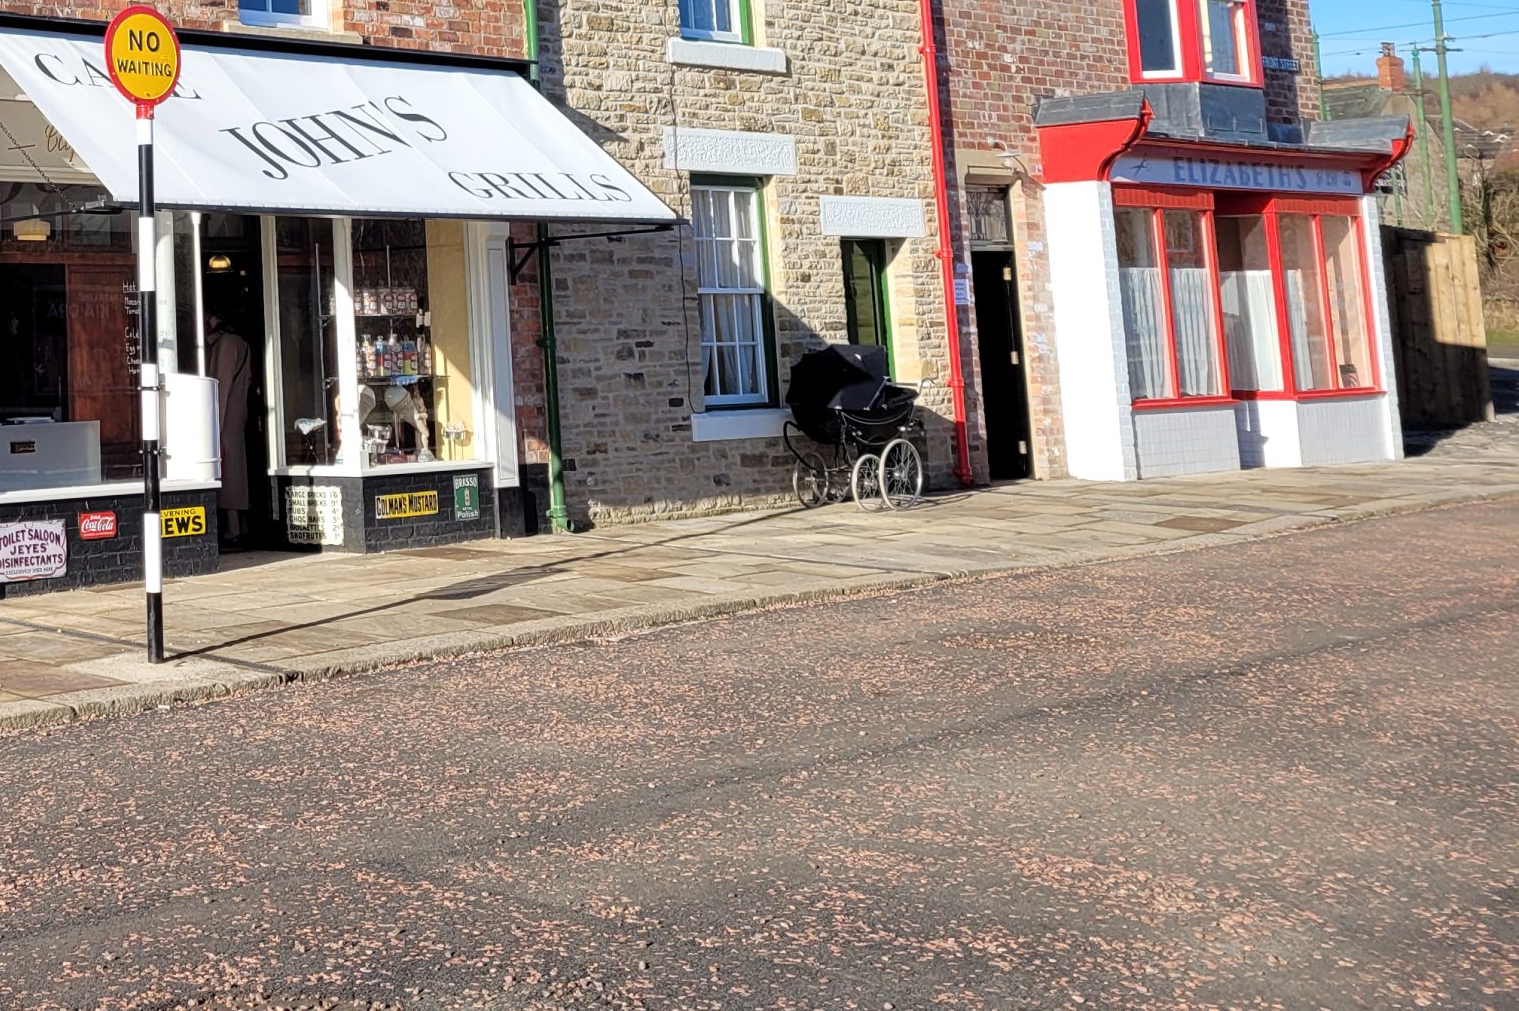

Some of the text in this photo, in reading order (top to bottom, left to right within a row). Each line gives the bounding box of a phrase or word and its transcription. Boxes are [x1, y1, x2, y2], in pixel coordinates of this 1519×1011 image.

[128, 29, 161, 53] NO
[116, 57, 172, 78] WAITING
[219, 95, 448, 180] JOHN'S
[1173, 156, 1307, 189] ELIZABETH'S
[447, 171, 632, 203] GRILLS
[160, 509, 196, 517] VENING
[376, 493, 437, 517] COLMAN'S MUSTARD
[28, 528, 61, 546] SALOON
[160, 515, 203, 535] EWS
